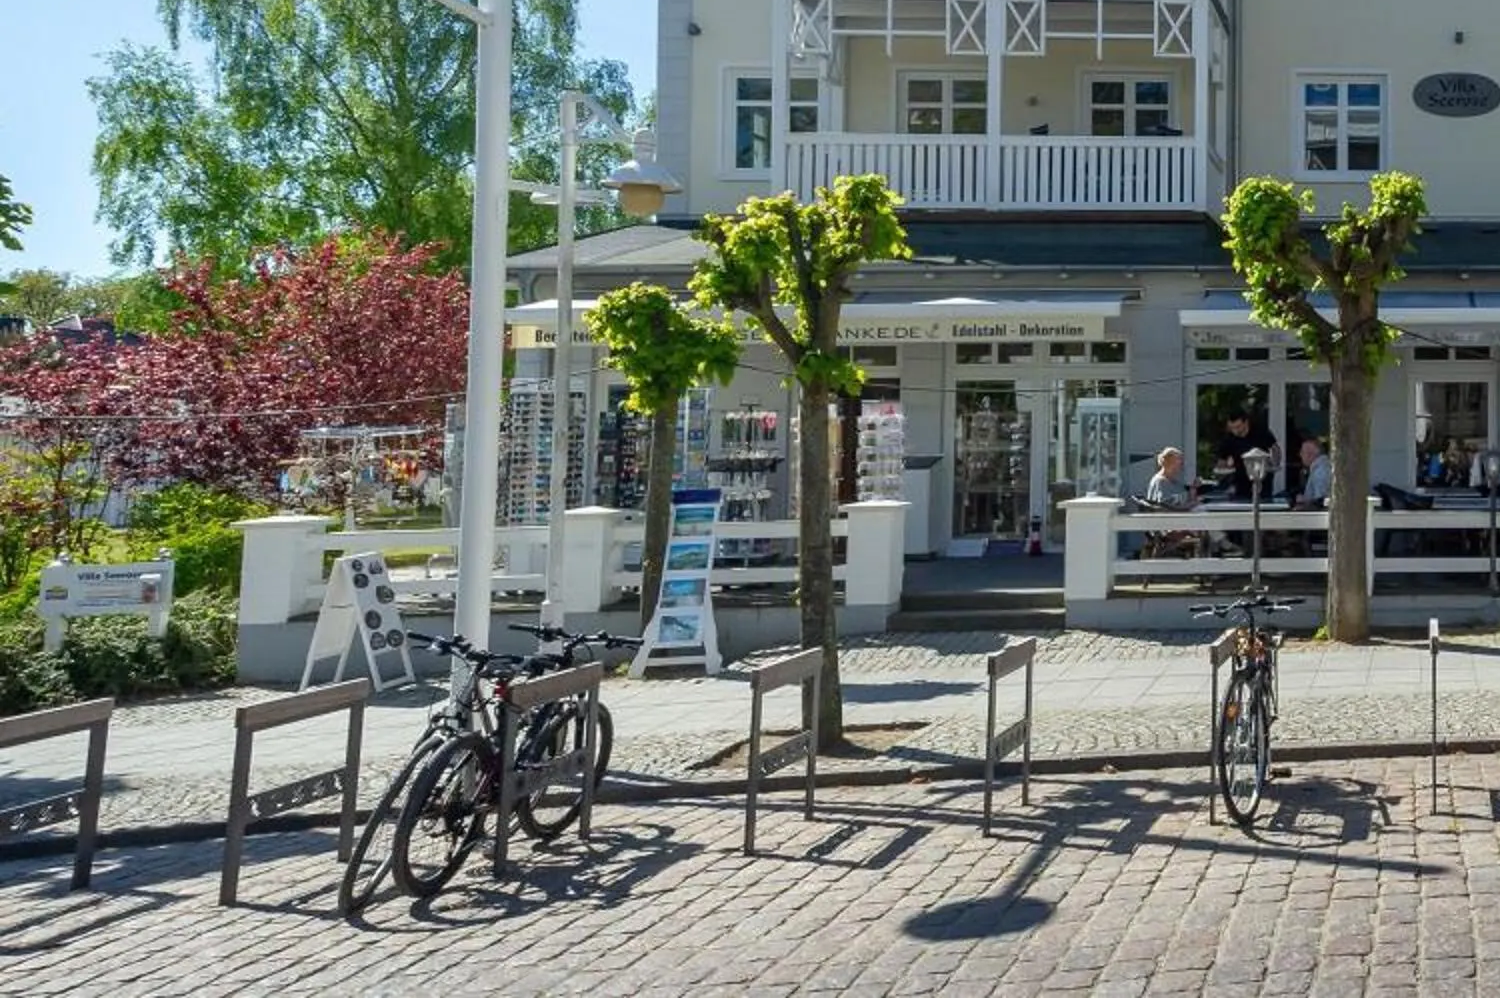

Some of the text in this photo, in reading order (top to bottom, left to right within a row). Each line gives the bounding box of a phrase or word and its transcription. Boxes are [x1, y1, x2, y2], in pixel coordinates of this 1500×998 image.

[1438, 77, 1477, 93] Villa
[952, 323, 1007, 337] Edelstahl
[1019, 324, 1085, 337] Dekoration
